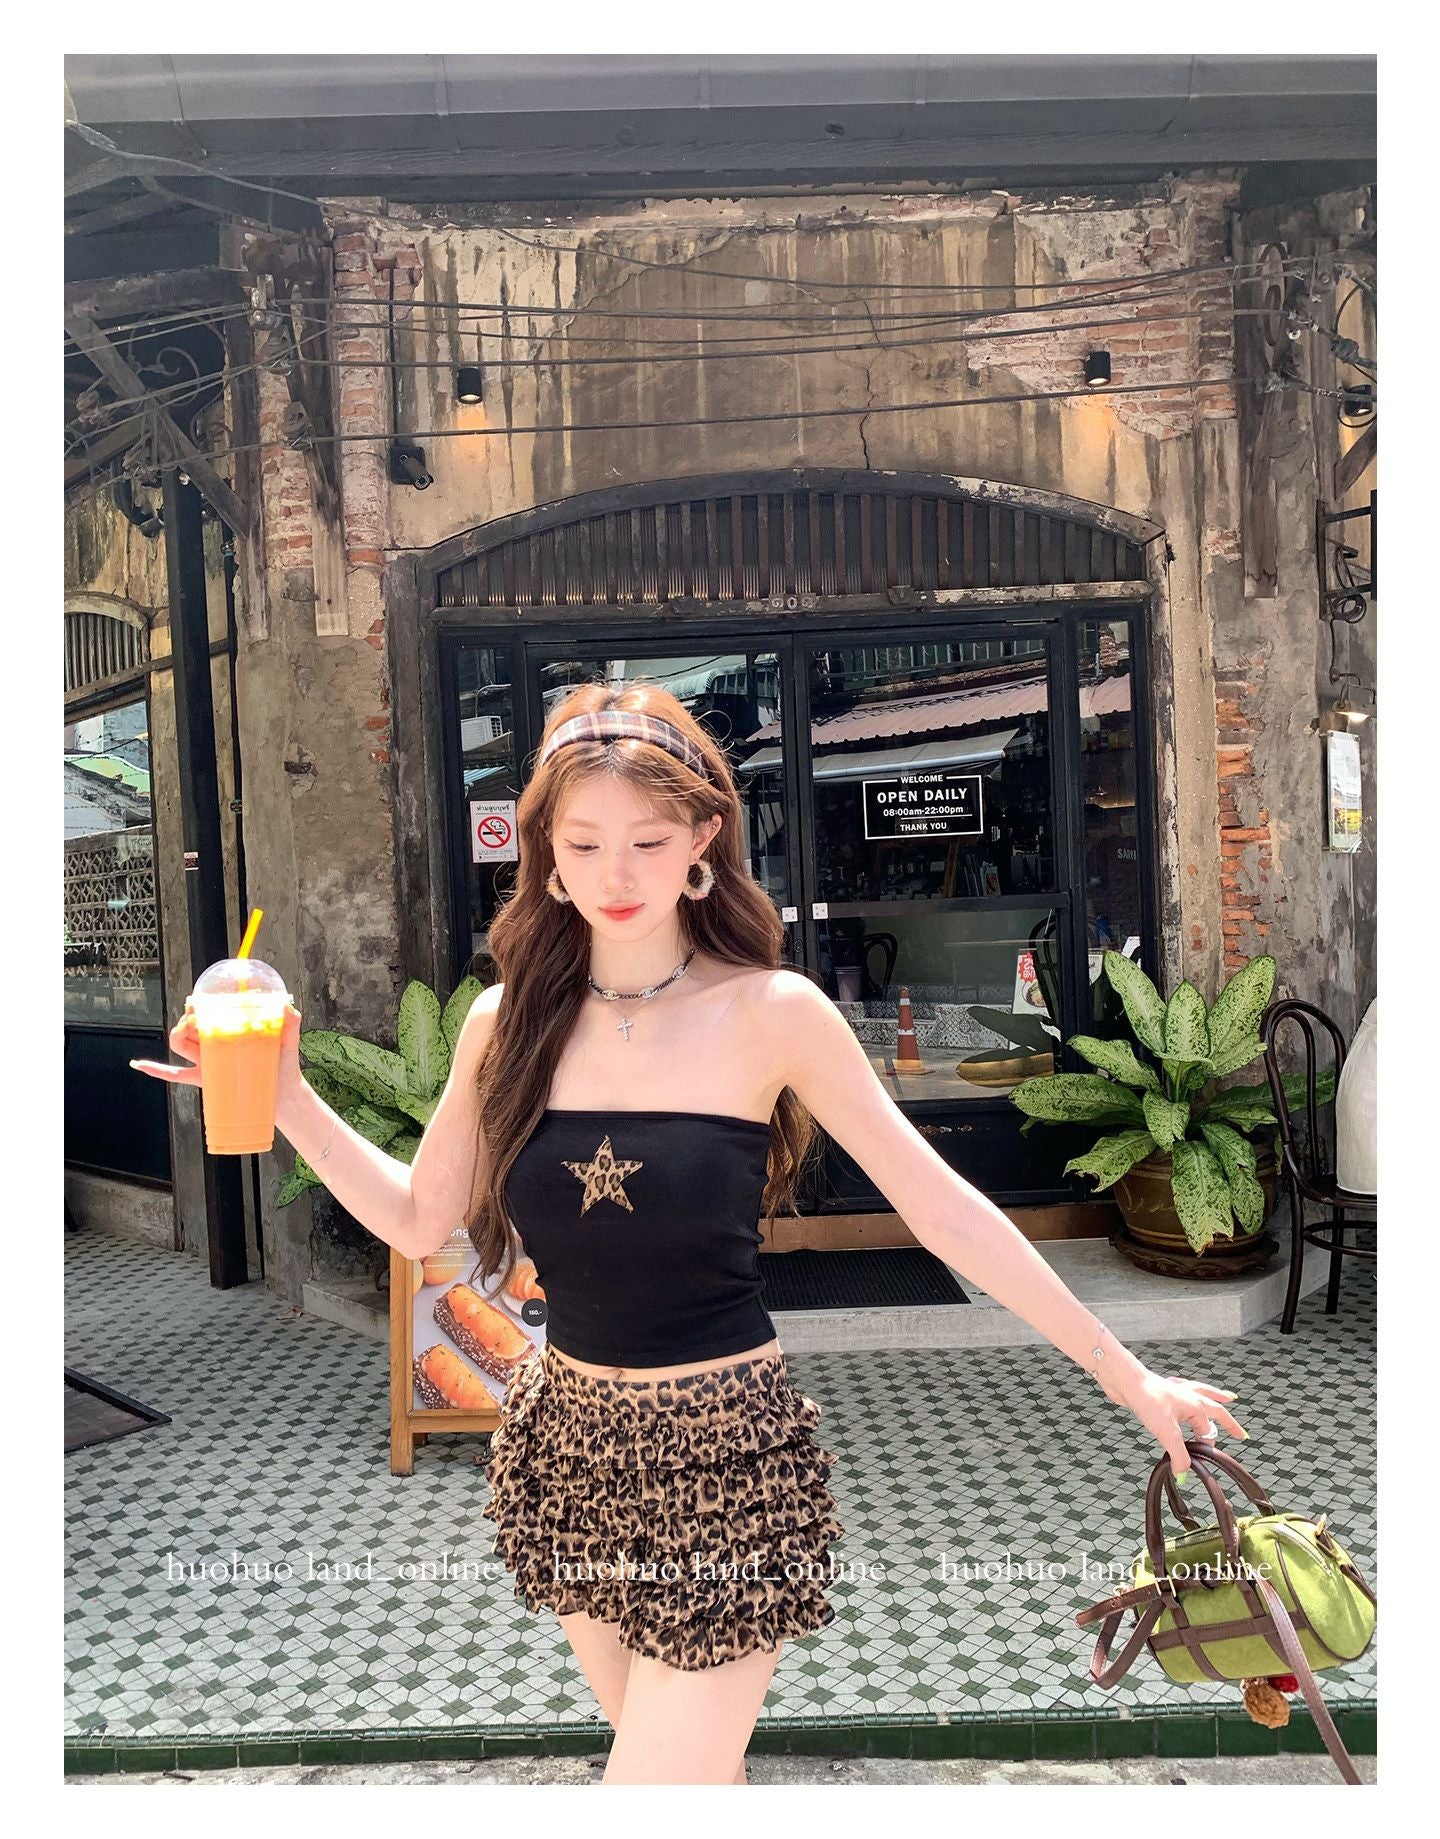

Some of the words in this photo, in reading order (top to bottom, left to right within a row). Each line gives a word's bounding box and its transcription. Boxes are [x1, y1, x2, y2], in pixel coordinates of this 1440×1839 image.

[900, 775, 944, 784] WELCOME
[877, 790, 918, 804] OPEN
[924, 787, 968, 801] DAILY
[883, 806, 964, 817] 08:00am-22:00pm
[900, 823, 928, 832] THANK
[930, 822, 947, 830] YOU
